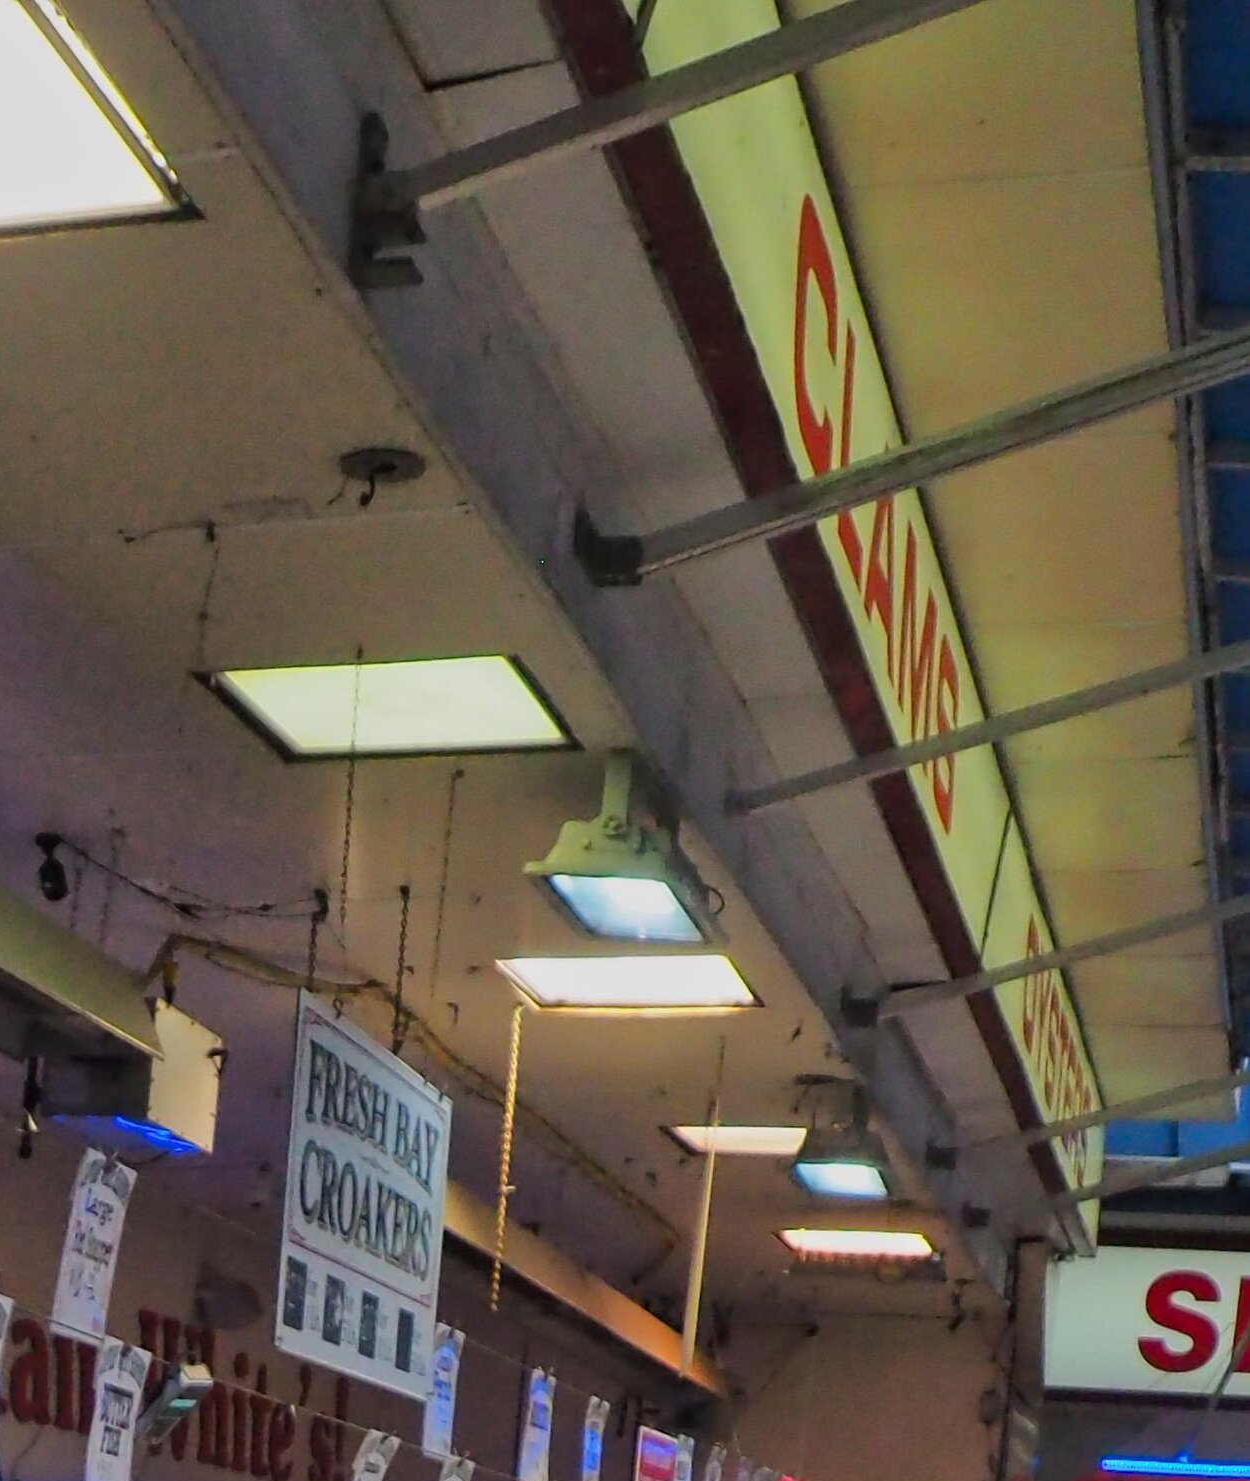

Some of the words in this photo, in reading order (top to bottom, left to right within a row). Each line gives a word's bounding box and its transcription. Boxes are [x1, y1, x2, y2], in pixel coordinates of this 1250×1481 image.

[794, 193, 959, 836] CLAMS
[304, 1038, 390, 1151] FRESH
[395, 1098, 442, 1199] BAY
[299, 1138, 435, 1284] CROAKERS
